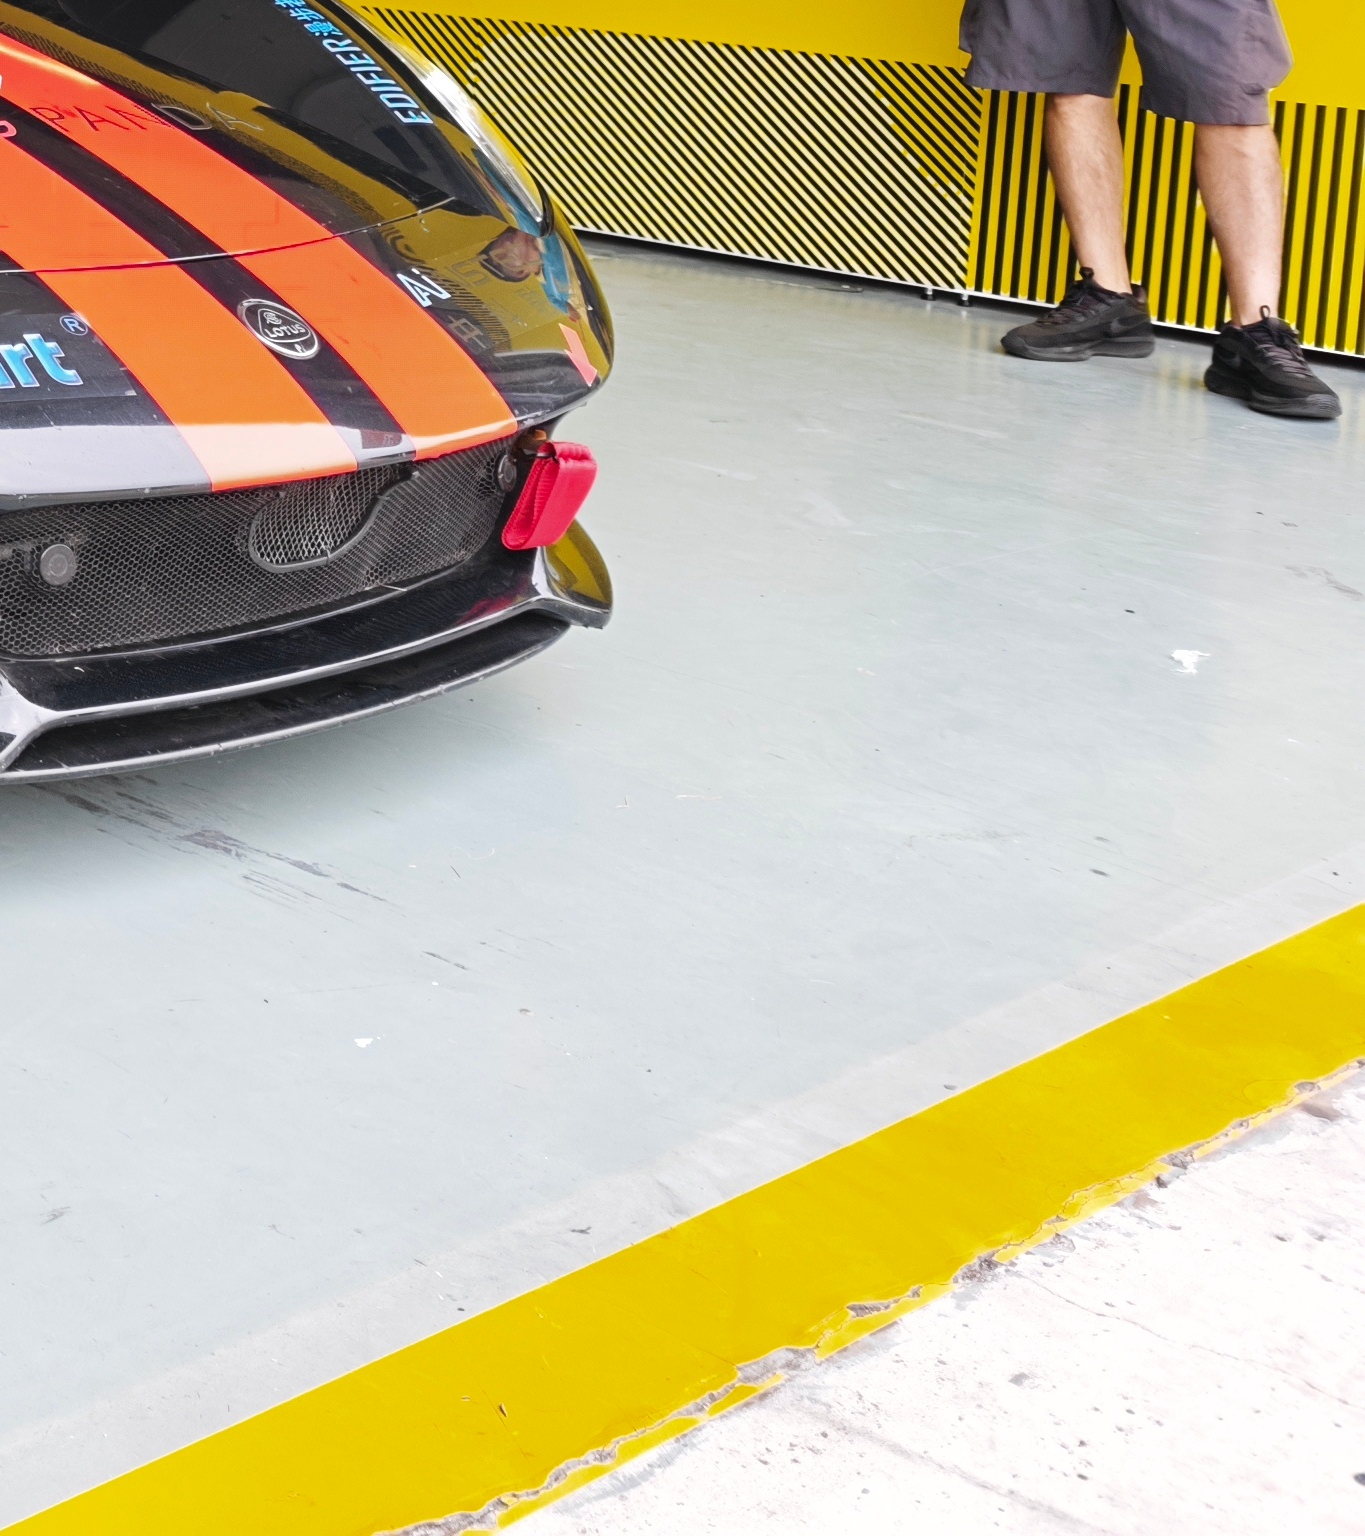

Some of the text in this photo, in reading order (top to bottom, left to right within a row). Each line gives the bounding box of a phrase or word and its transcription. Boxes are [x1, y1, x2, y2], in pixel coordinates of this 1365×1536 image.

[322, 38, 434, 125] EDIFIER
[29, 101, 264, 137] PANDA
[264, 323, 306, 338] LOTUS
